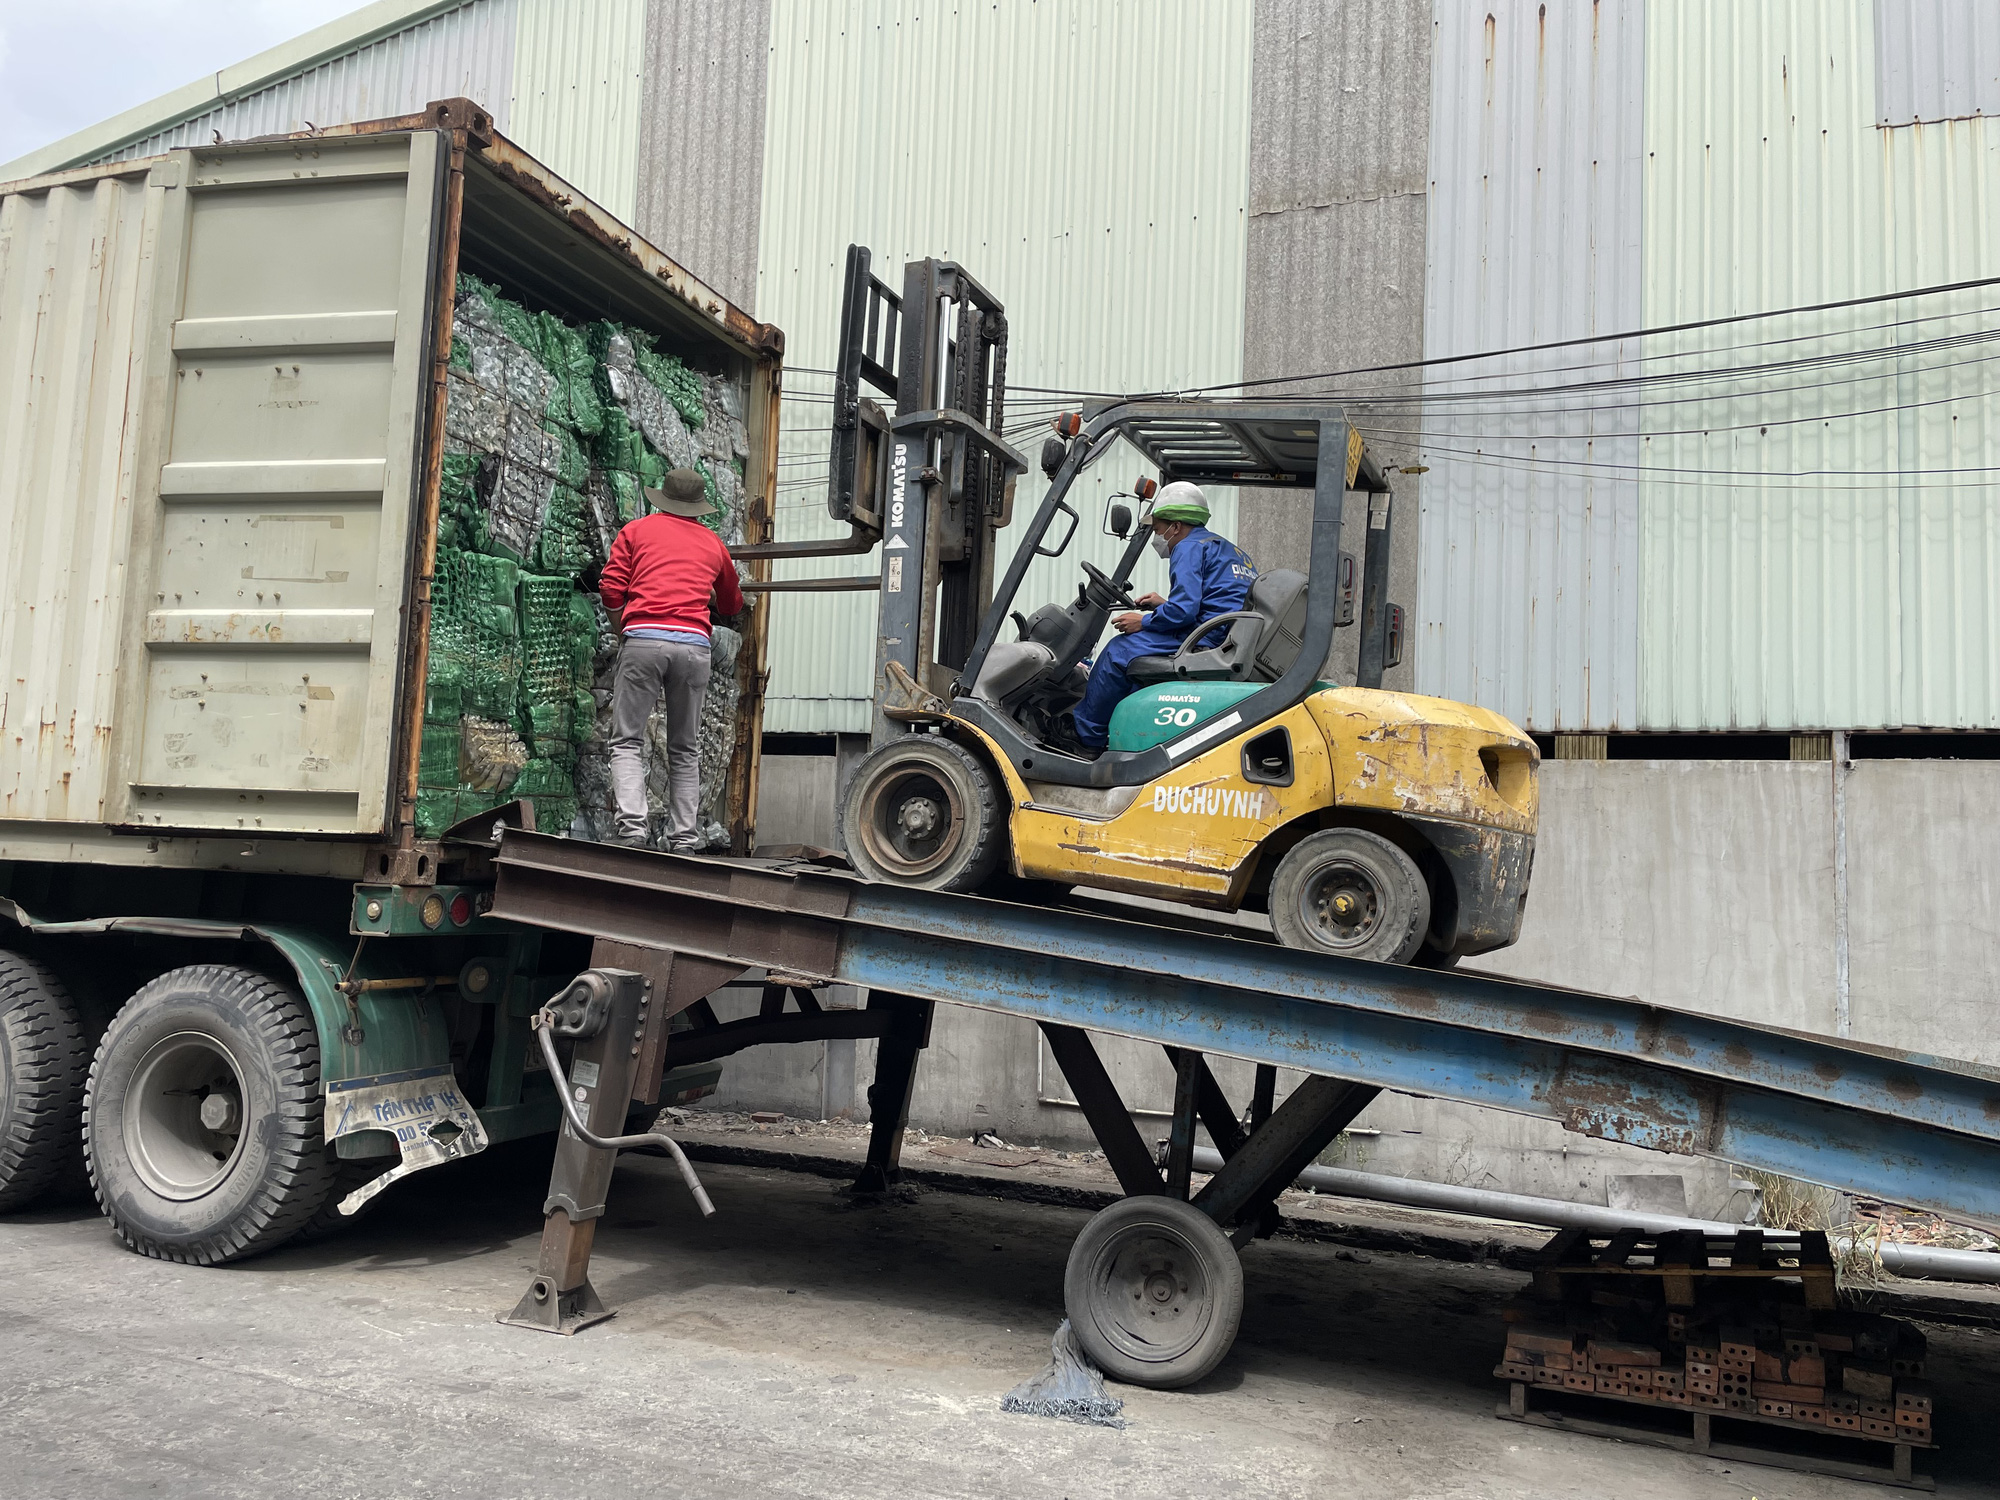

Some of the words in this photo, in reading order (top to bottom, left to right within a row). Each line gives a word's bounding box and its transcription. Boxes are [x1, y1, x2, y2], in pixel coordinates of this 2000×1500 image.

[890, 443, 907, 528] KOMATSU
[1157, 694, 1201, 703] KOMATSU
[1154, 706, 1197, 727] 30
[1153, 785, 1264, 820] DUCHUYNH
